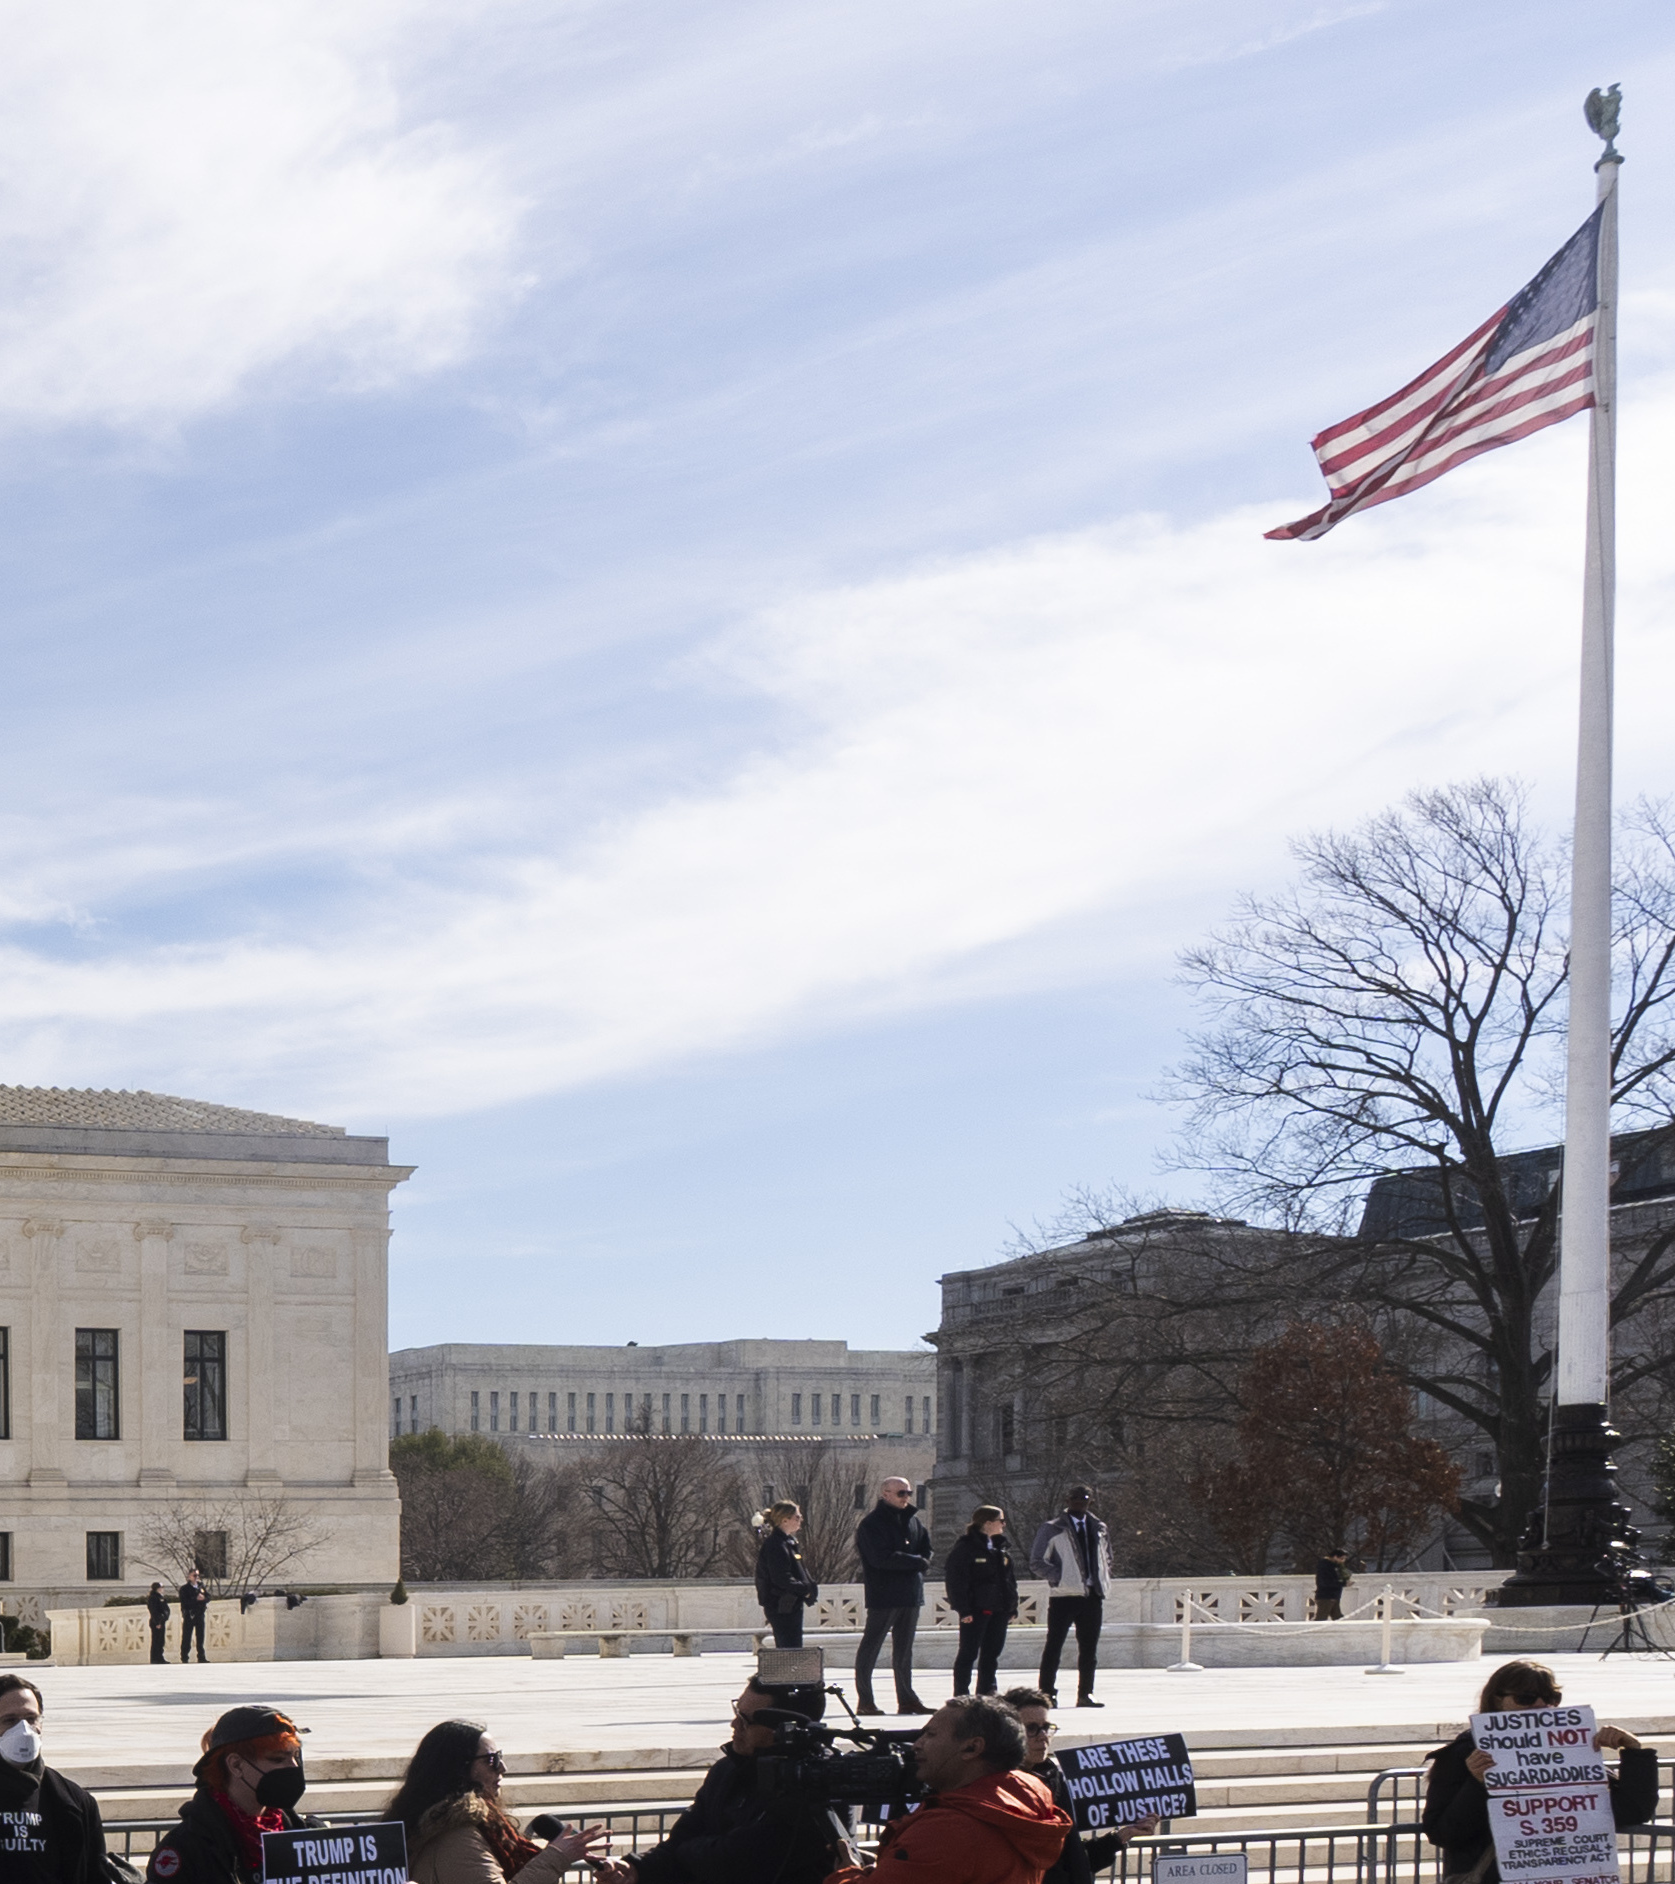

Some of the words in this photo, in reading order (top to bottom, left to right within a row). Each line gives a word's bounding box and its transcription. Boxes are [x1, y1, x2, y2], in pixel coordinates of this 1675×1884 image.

[1484, 1709, 1582, 1731] JUSTICES
[1479, 1732, 1542, 1750] should
[1547, 1728, 1591, 1746] NOT
[1076, 1746, 1114, 1770] ARE
[1111, 1738, 1171, 1764] THESE
[1516, 1751, 1565, 1766] have
[1067, 1770, 1140, 1800] HOLLOW
[1141, 1763, 1193, 1790] HALLS
[1087, 1803, 1110, 1827] OF
[1114, 1793, 1187, 1824] JUSTICE?
[1502, 1794, 1599, 1817] SUPPORT
[14, 1825, 29, 1838] IS
[1520, 1820, 1539, 1836] S.
[1541, 1816, 1578, 1834] 359
[0, 1838, 47, 1852] UILTY
[293, 1837, 355, 1867] TRUMP
[359, 1835, 378, 1862] IS
[1514, 1836, 1567, 1849] SUPREME
[1573, 1833, 1610, 1844] COURT
[1167, 1864, 1196, 1878] AREA
[1199, 1863, 1238, 1876] CLOSED
[1501, 1855, 1588, 1870] TRANSPARENCY
[1590, 1852, 1611, 1862] ACT
